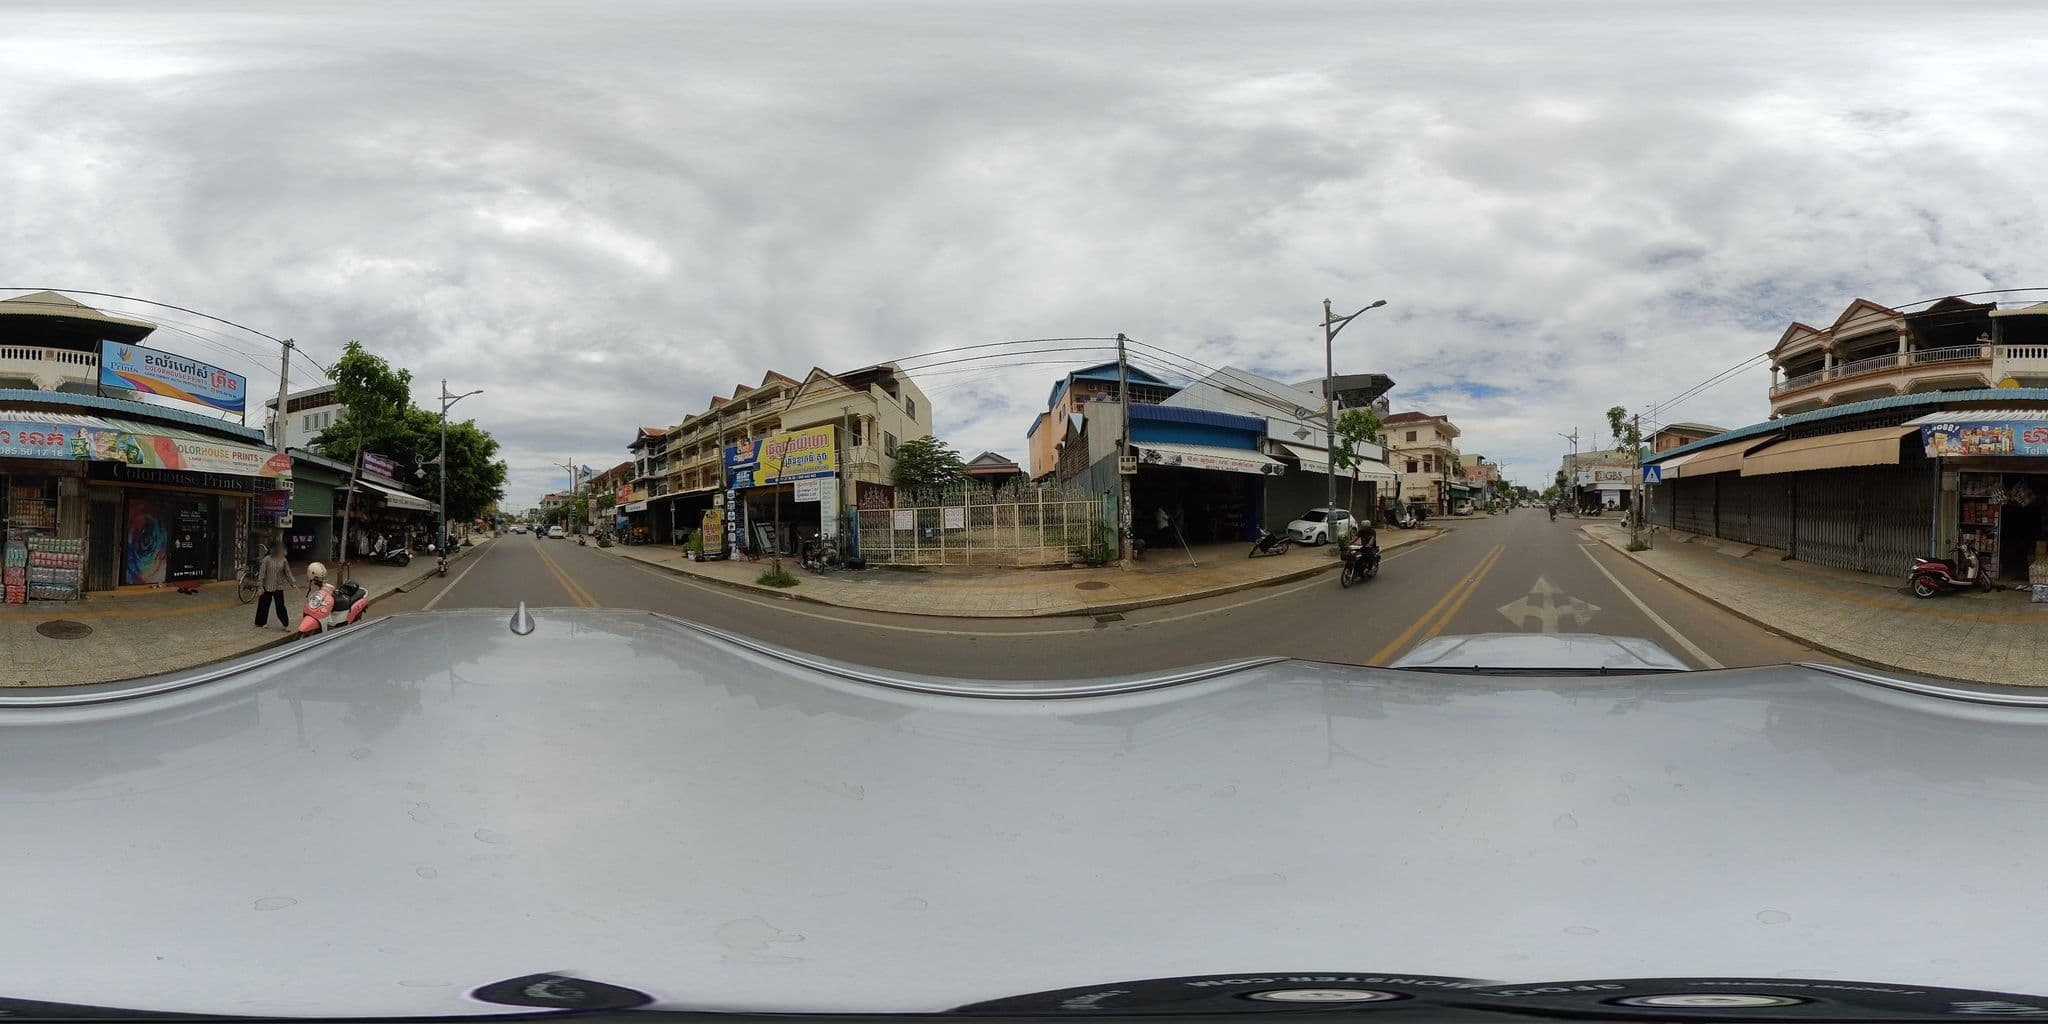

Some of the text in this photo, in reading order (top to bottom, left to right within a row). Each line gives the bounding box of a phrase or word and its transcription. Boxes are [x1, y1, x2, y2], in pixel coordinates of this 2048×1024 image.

[144, 365, 186, 380] COLORHOUSE
[20, 447, 33, 455] 50
[37, 448, 49, 456] 17
[51, 448, 63, 457] 18
[232, 451, 259, 462] PRINTS
[203, 473, 242, 489] Prints
